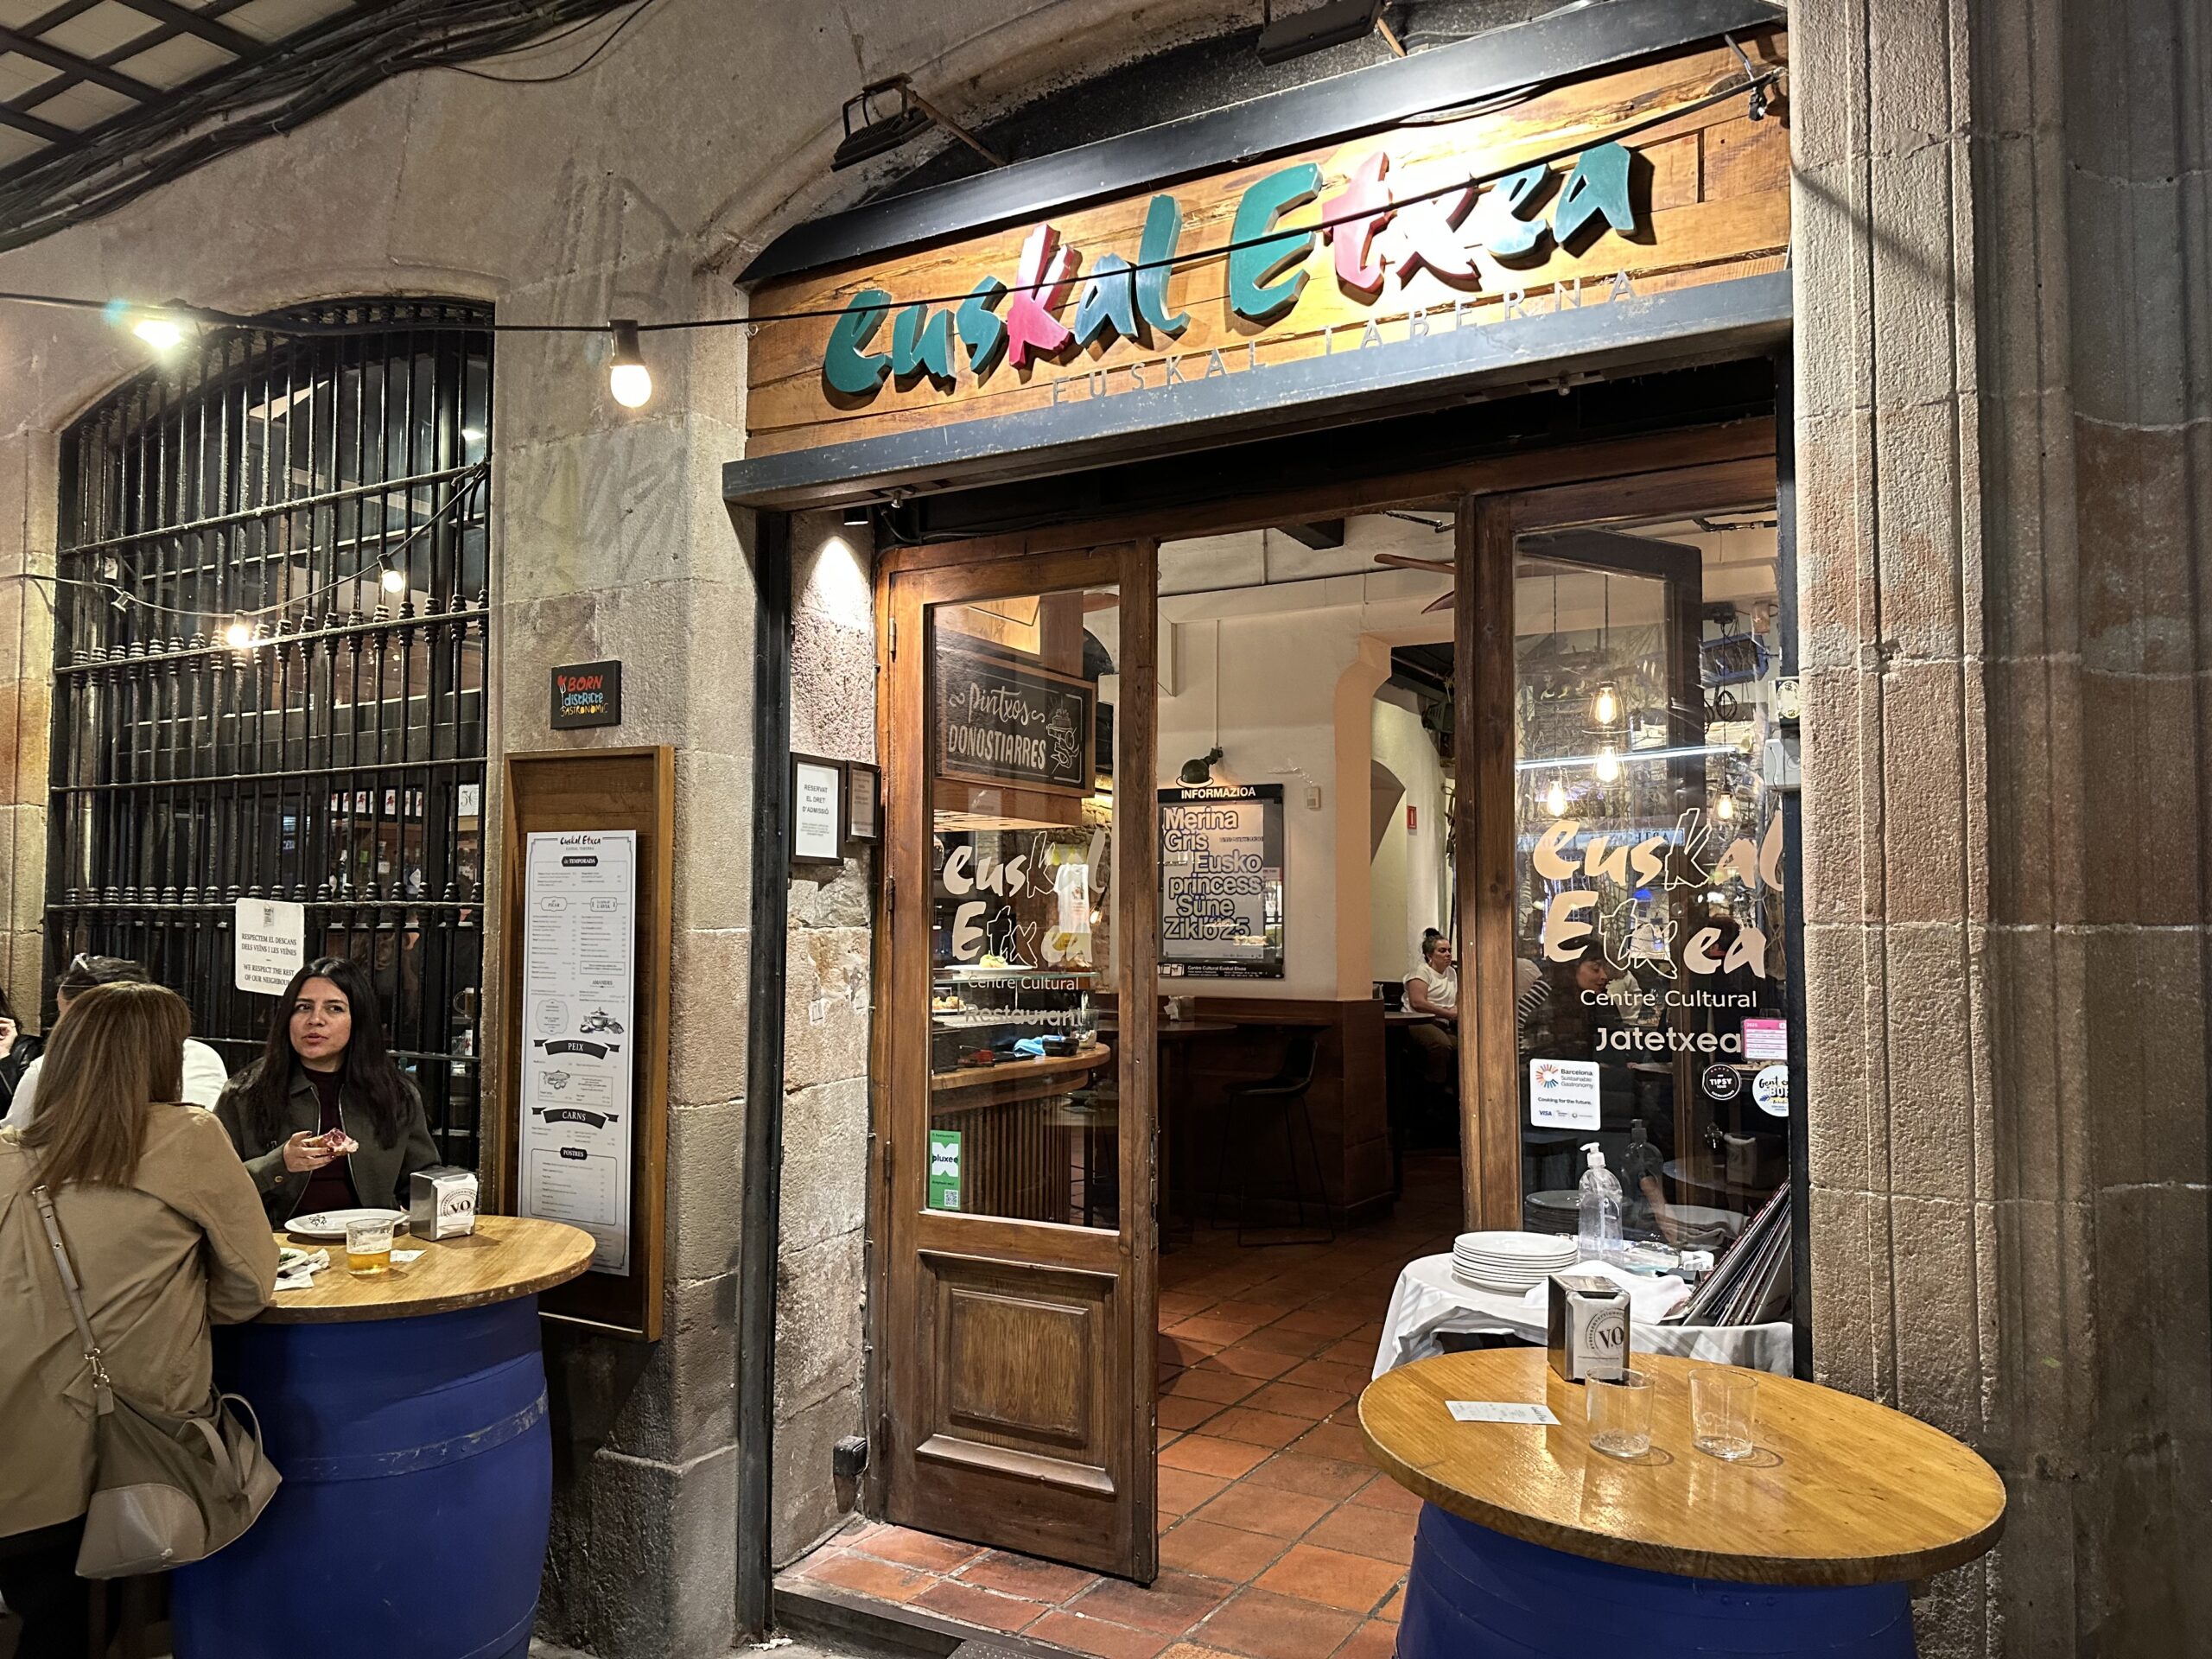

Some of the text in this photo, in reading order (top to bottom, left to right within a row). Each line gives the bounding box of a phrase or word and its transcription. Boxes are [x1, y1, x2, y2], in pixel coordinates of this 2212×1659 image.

[1052, 267, 1637, 407] EUSKAL TABERNA
[568, 675, 603, 692] BORN
[948, 724, 1046, 771] DONOSTIARRES
[804, 784, 828, 793] RESERVAT
[1180, 786, 1256, 800] INFORMAZIOA
[1164, 806, 1239, 830] Merina
[1163, 829, 1209, 852] Gris
[569, 856, 596, 865] TEMPORADA
[1192, 849, 1262, 874] Eusko
[1168, 872, 1263, 899] princess
[1176, 893, 1236, 917] Süne
[241, 932, 268, 943] RESPECTEM
[275, 938, 297, 946] DESCANS
[1543, 889, 1767, 981] Etxea
[252, 964, 272, 974] RESPECT
[272, 967, 283, 976] THE
[283, 968, 295, 976] REST
[968, 975, 1080, 991] Centre Cultural
[1580, 989, 1757, 1007] Centre Cultural
[964, 1003, 1084, 1027] Restaurant
[568, 1042, 584, 1052] PEIX
[1595, 1027, 1742, 1053] Jatetxea
[1560, 1068, 1593, 1077] Barcelona
[1709, 1077, 1732, 1086] TIPSY
[562, 1110, 587, 1122] CARNS
[563, 1149, 584, 1158] POSTRES
[931, 1154, 959, 1164] pluxee
